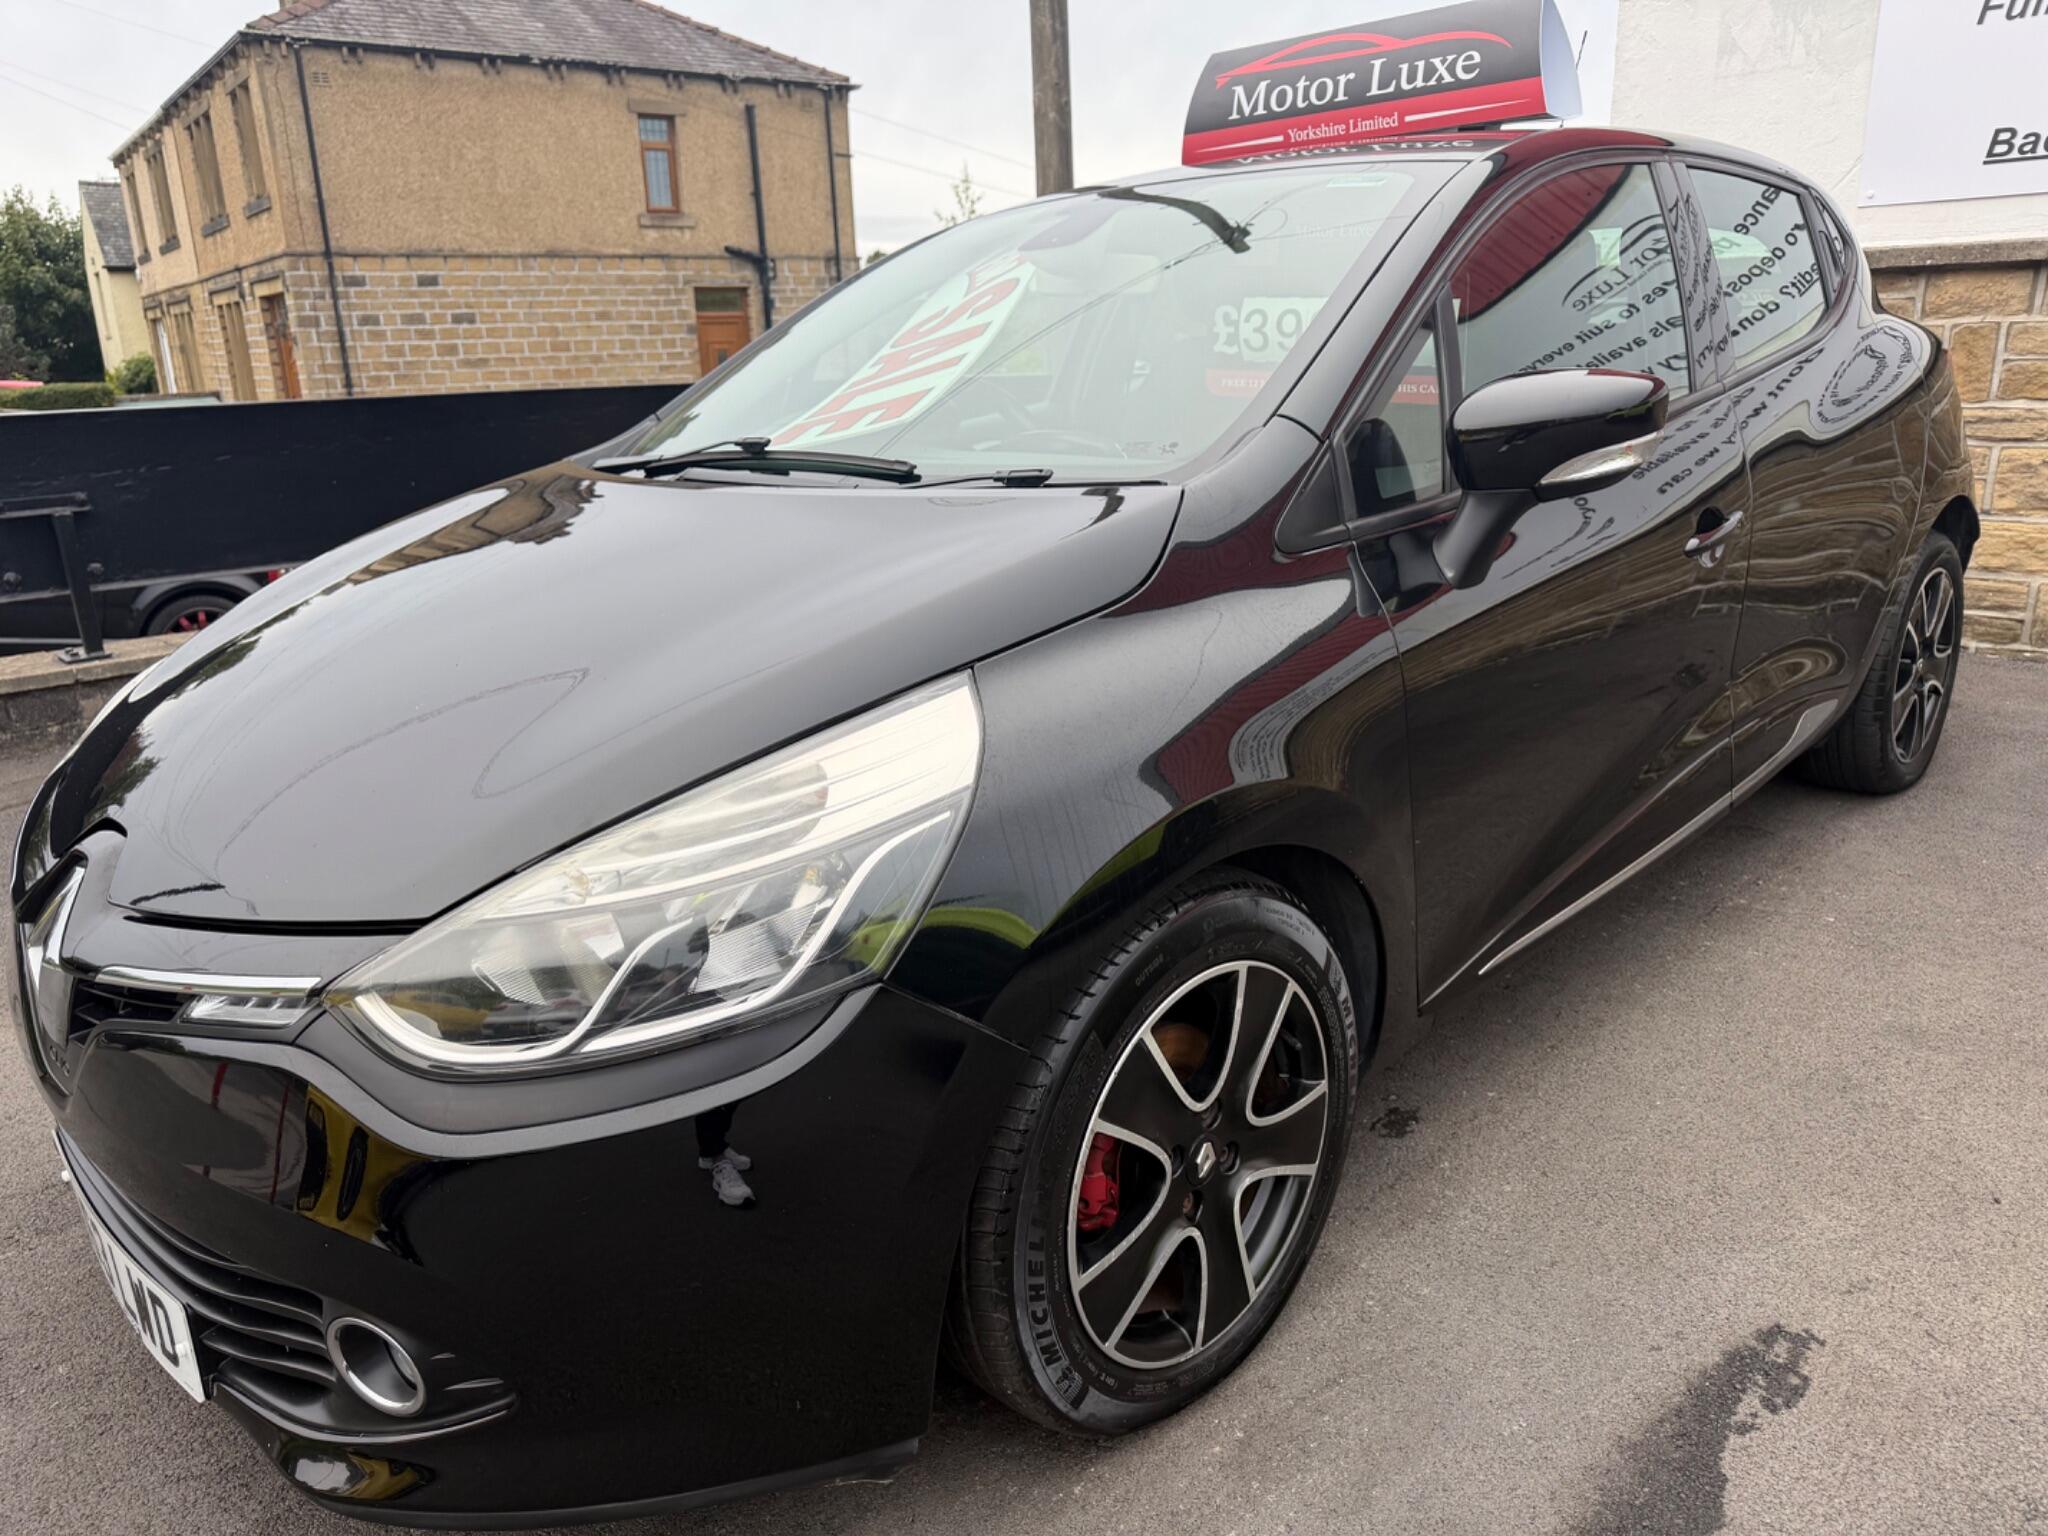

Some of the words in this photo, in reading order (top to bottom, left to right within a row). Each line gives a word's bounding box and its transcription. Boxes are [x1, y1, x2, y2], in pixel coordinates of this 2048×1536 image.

[1228, 71, 1355, 121] Motor
[1366, 50, 1482, 97] Luxe
[1288, 119, 1346, 143] Yorkshire
[1349, 112, 1399, 138] Limited
[1213, 304, 1318, 355] £39
[770, 276, 1022, 447] SALE
